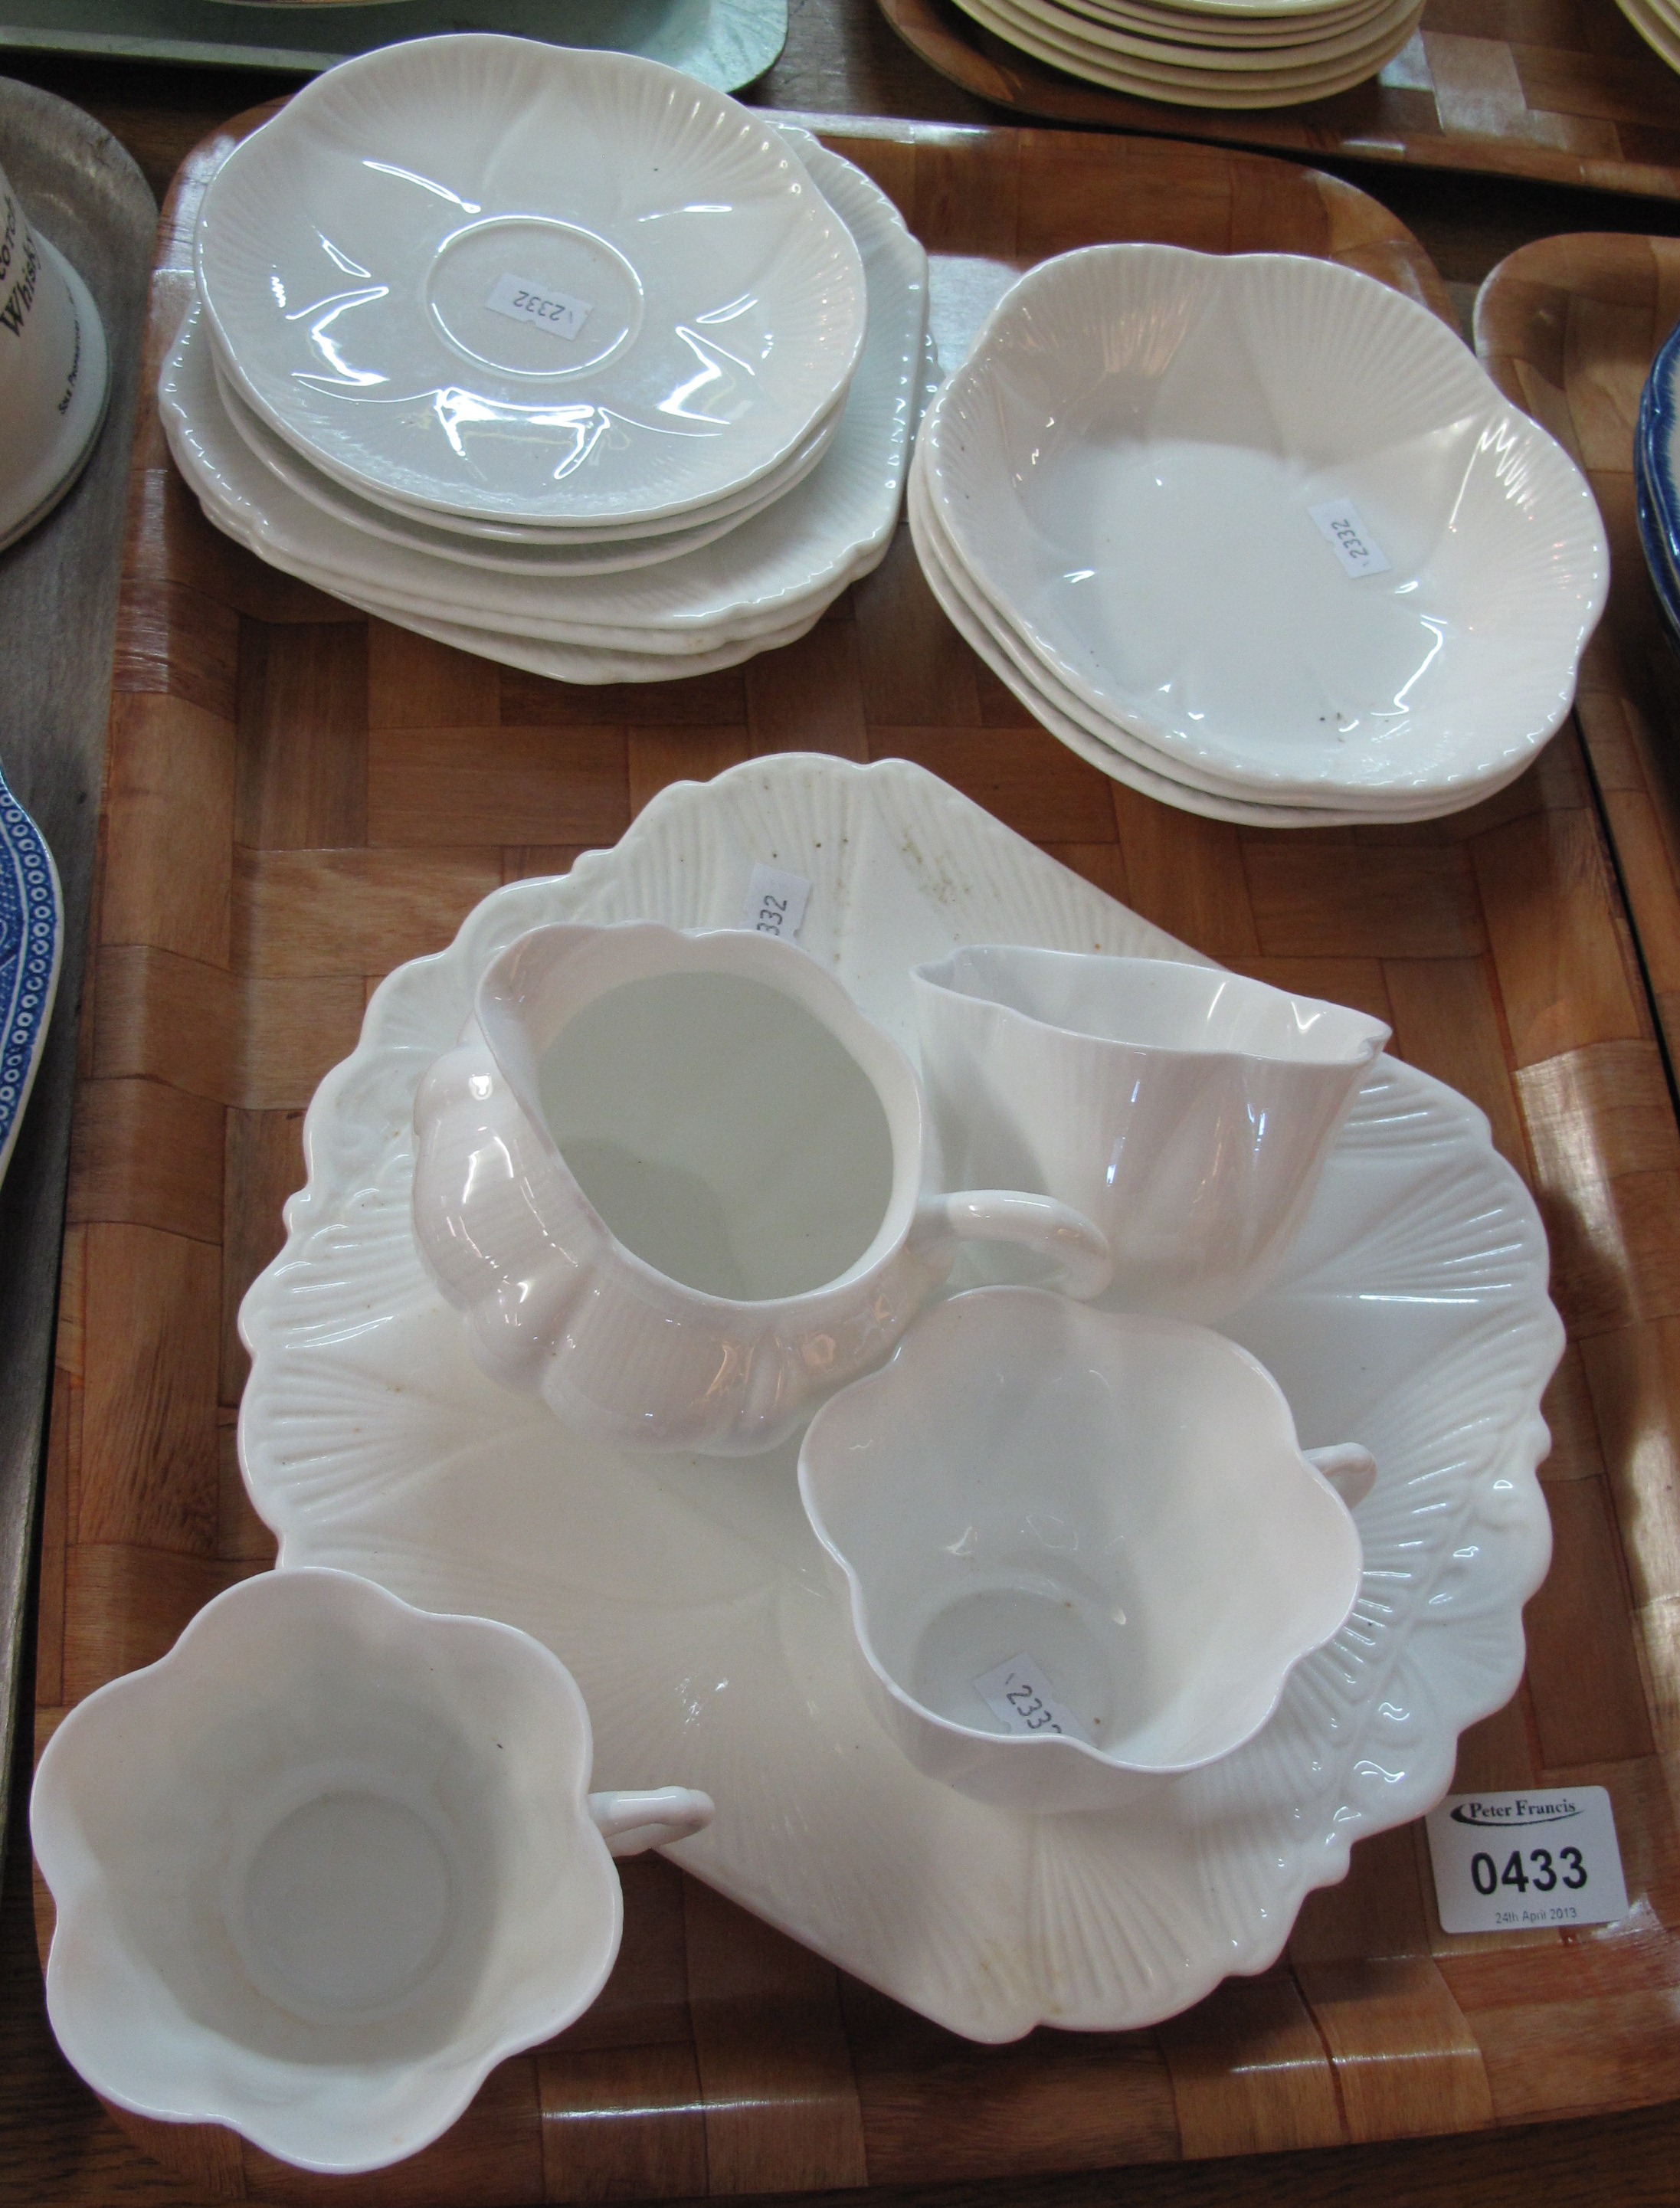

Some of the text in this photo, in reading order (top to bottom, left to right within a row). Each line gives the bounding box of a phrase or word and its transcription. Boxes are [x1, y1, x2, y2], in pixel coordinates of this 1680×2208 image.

[756, 895, 788, 936] 332
[1469, 1798, 1577, 1819] Peter Francis
[1470, 1846, 1588, 1895] 0433
[1495, 1907, 1577, 1924] 24th April 2013
